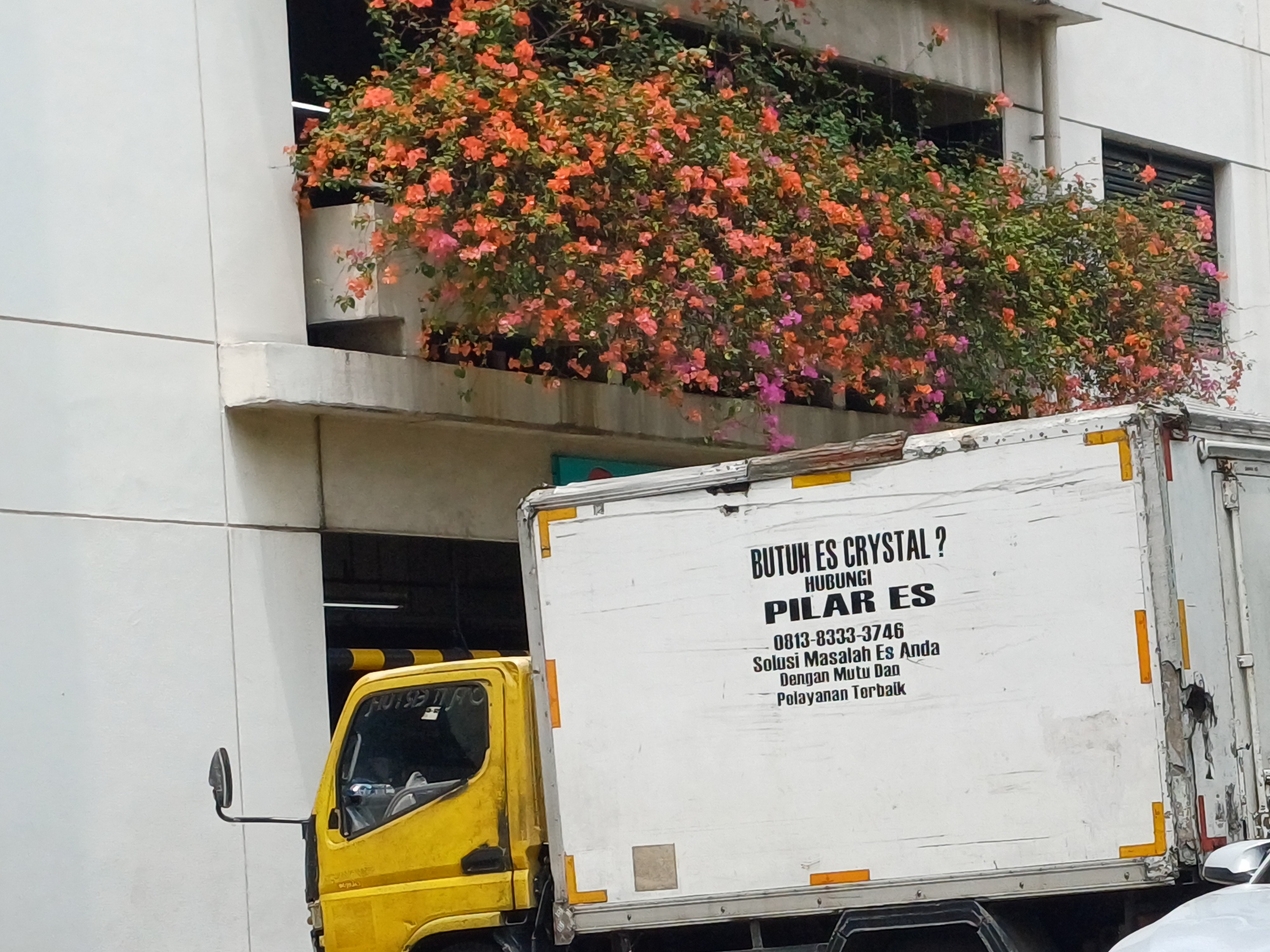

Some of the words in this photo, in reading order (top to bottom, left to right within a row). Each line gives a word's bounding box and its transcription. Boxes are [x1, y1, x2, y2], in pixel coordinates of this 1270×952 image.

[751, 542, 810, 579] BUTUH
[815, 538, 838, 571] ES
[843, 528, 931, 567] CRYSTAL
[935, 526, 947, 558] ?
[804, 569, 873, 593] HUBUNGI
[764, 589, 876, 625] PILAR
[888, 582, 936, 610] ES
[773, 622, 904, 651] 0813-8333-3746
[753, 652, 800, 672] Solusi
[804, 645, 871, 668] Masalah
[876, 643, 895, 661] Es
[899, 640, 941, 660] Anda
[780, 671, 830, 687] Dengan
[833, 666, 871, 682] Mutu
[874, 663, 900, 678] Dan
